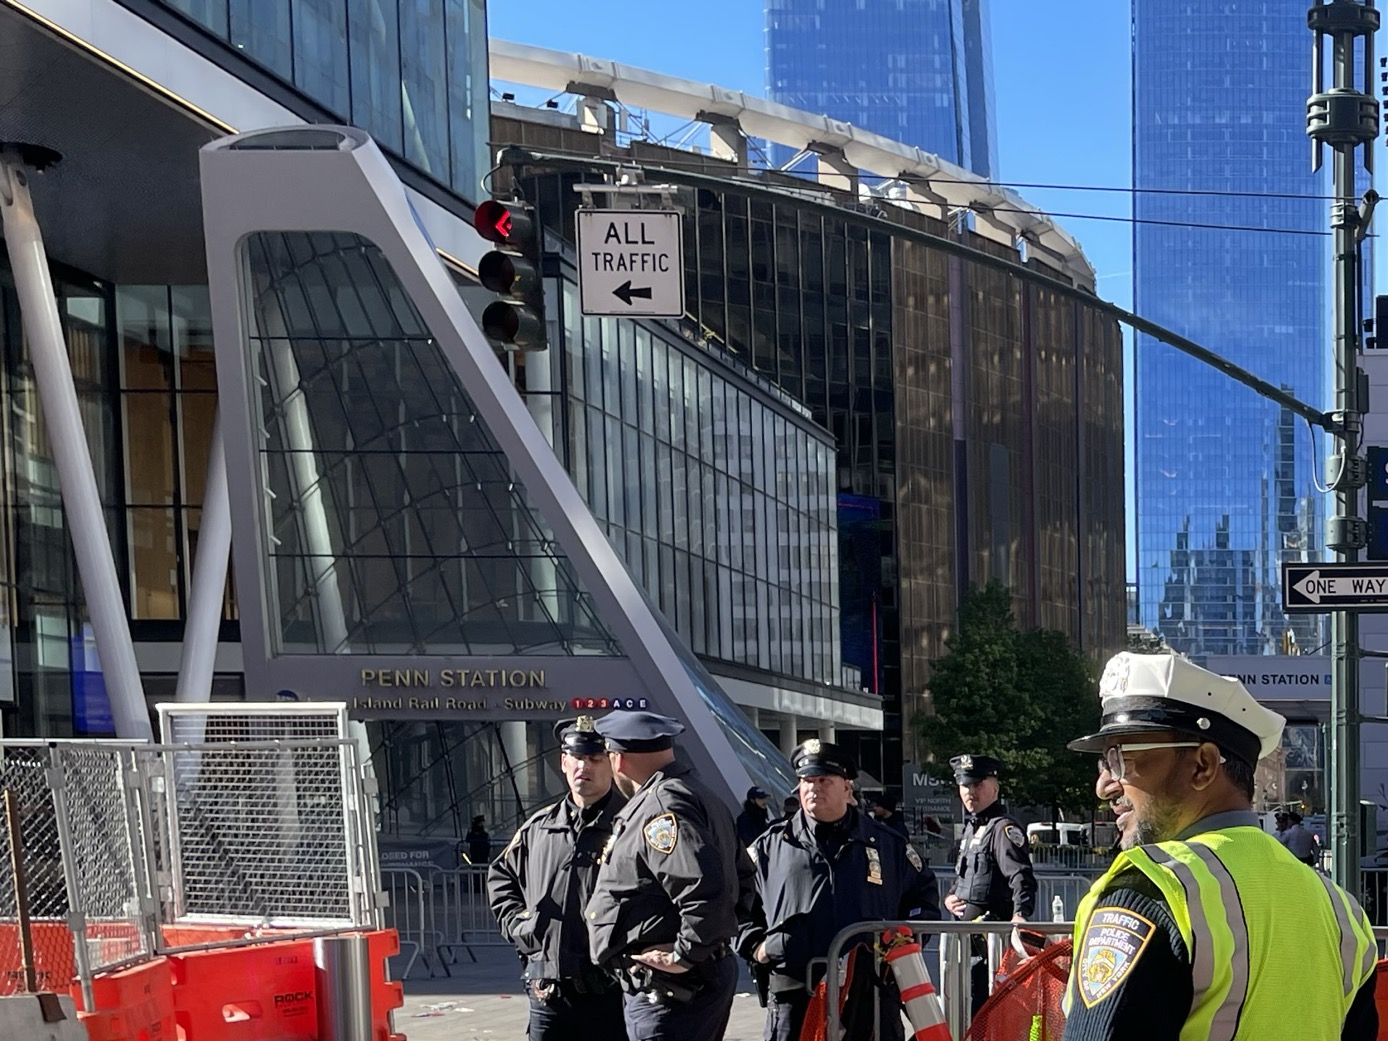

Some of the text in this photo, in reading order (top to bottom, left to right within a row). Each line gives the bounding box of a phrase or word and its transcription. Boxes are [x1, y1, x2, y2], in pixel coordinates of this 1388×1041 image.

[604, 222, 655, 245] ALL
[591, 252, 669, 272] TRAFFIC
[1305, 580, 1387, 594] ONE WAY
[361, 669, 545, 687] PENN STATION
[1261, 674, 1320, 685] STATION
[353, 697, 402, 709] Island
[408, 697, 439, 709] Rail
[445, 697, 487, 709] Road
[504, 697, 567, 712] Subway
[1102, 912, 1140, 930] TRAFFIC
[1100, 928, 1131, 942] POLICE
[1088, 937, 1136, 955] DEPARTMENT
[1096, 962, 1131, 998] NEW YORK
